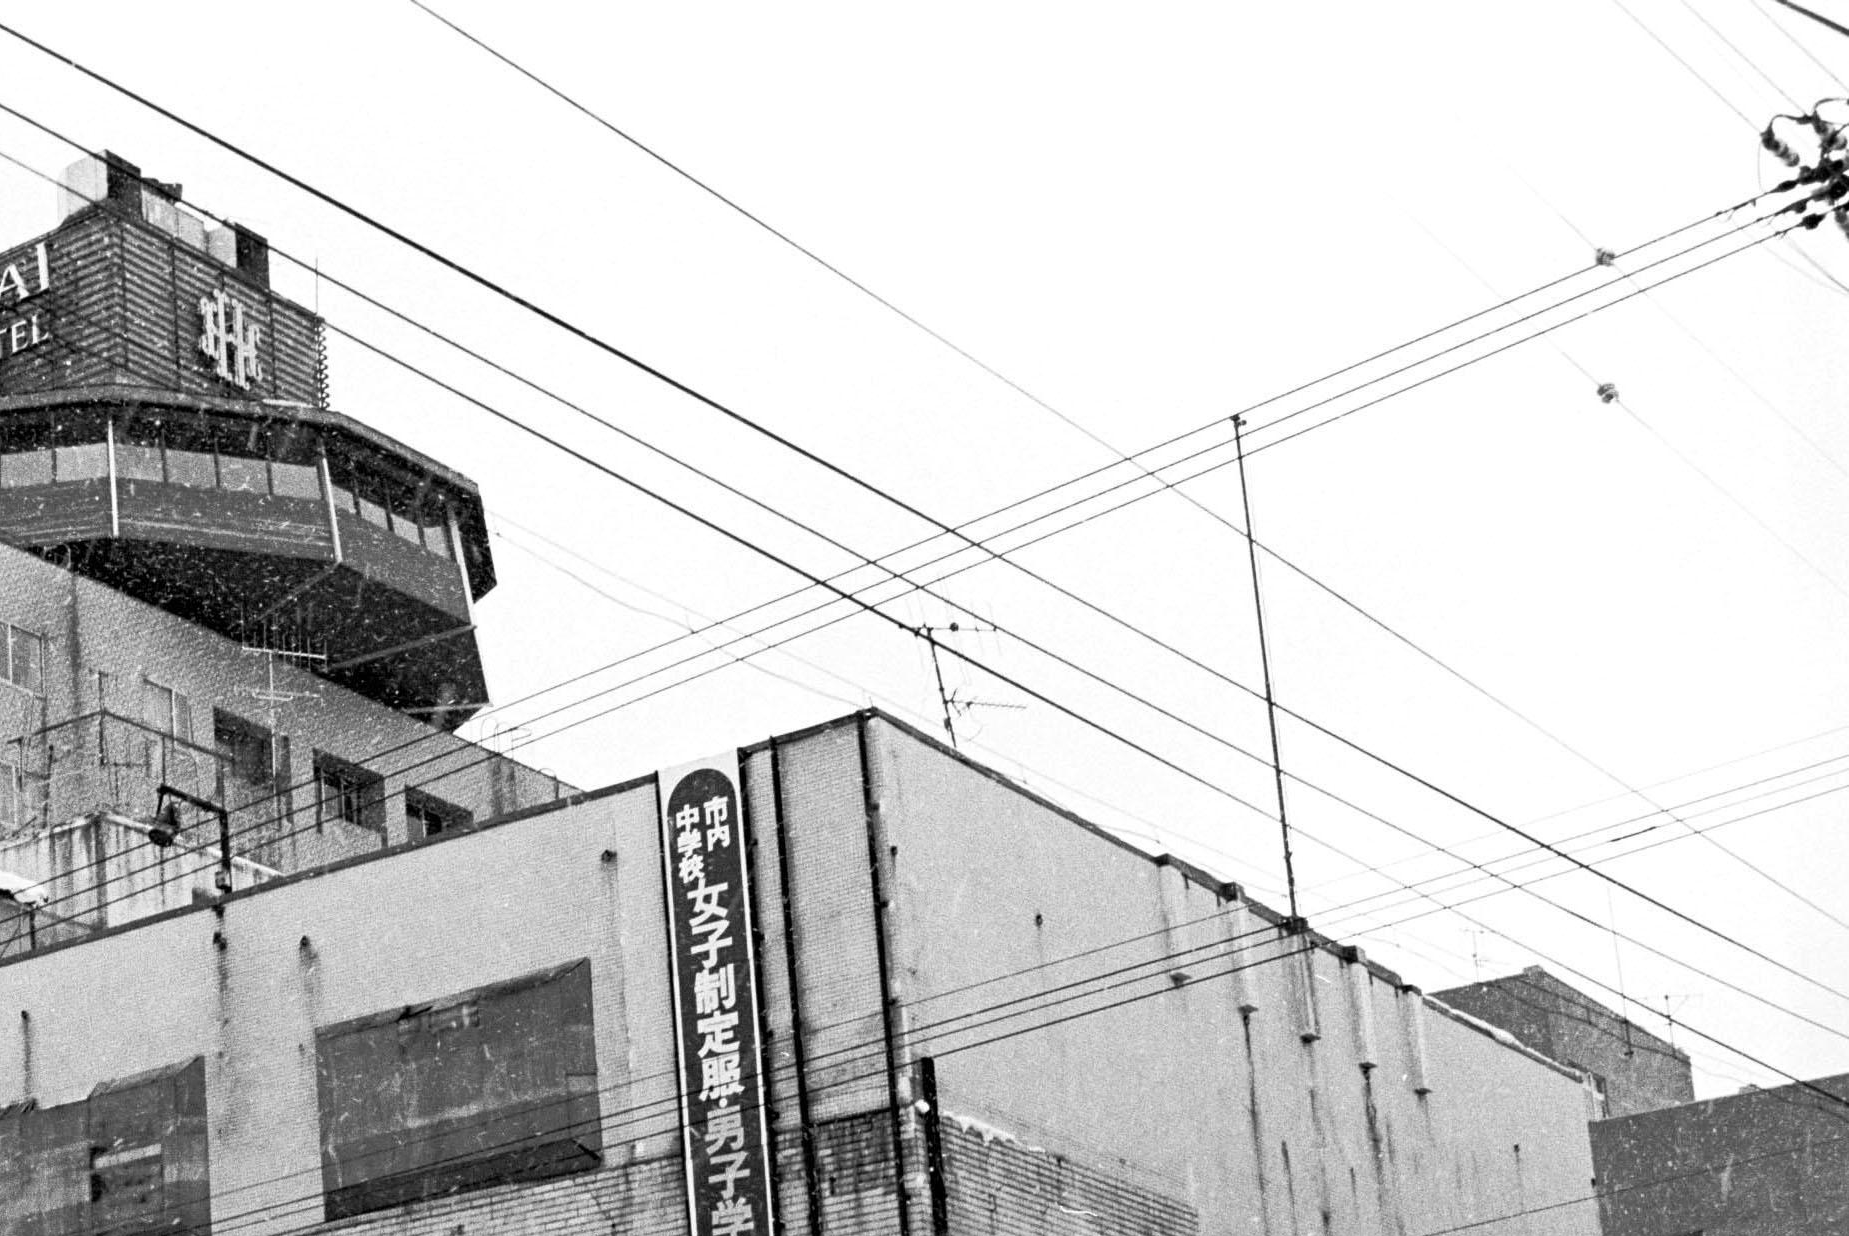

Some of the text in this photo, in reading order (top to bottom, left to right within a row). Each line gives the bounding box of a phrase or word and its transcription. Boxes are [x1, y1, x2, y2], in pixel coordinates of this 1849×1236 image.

[676, 804, 705, 884] 中学校
[704, 796, 731, 852] 市内
